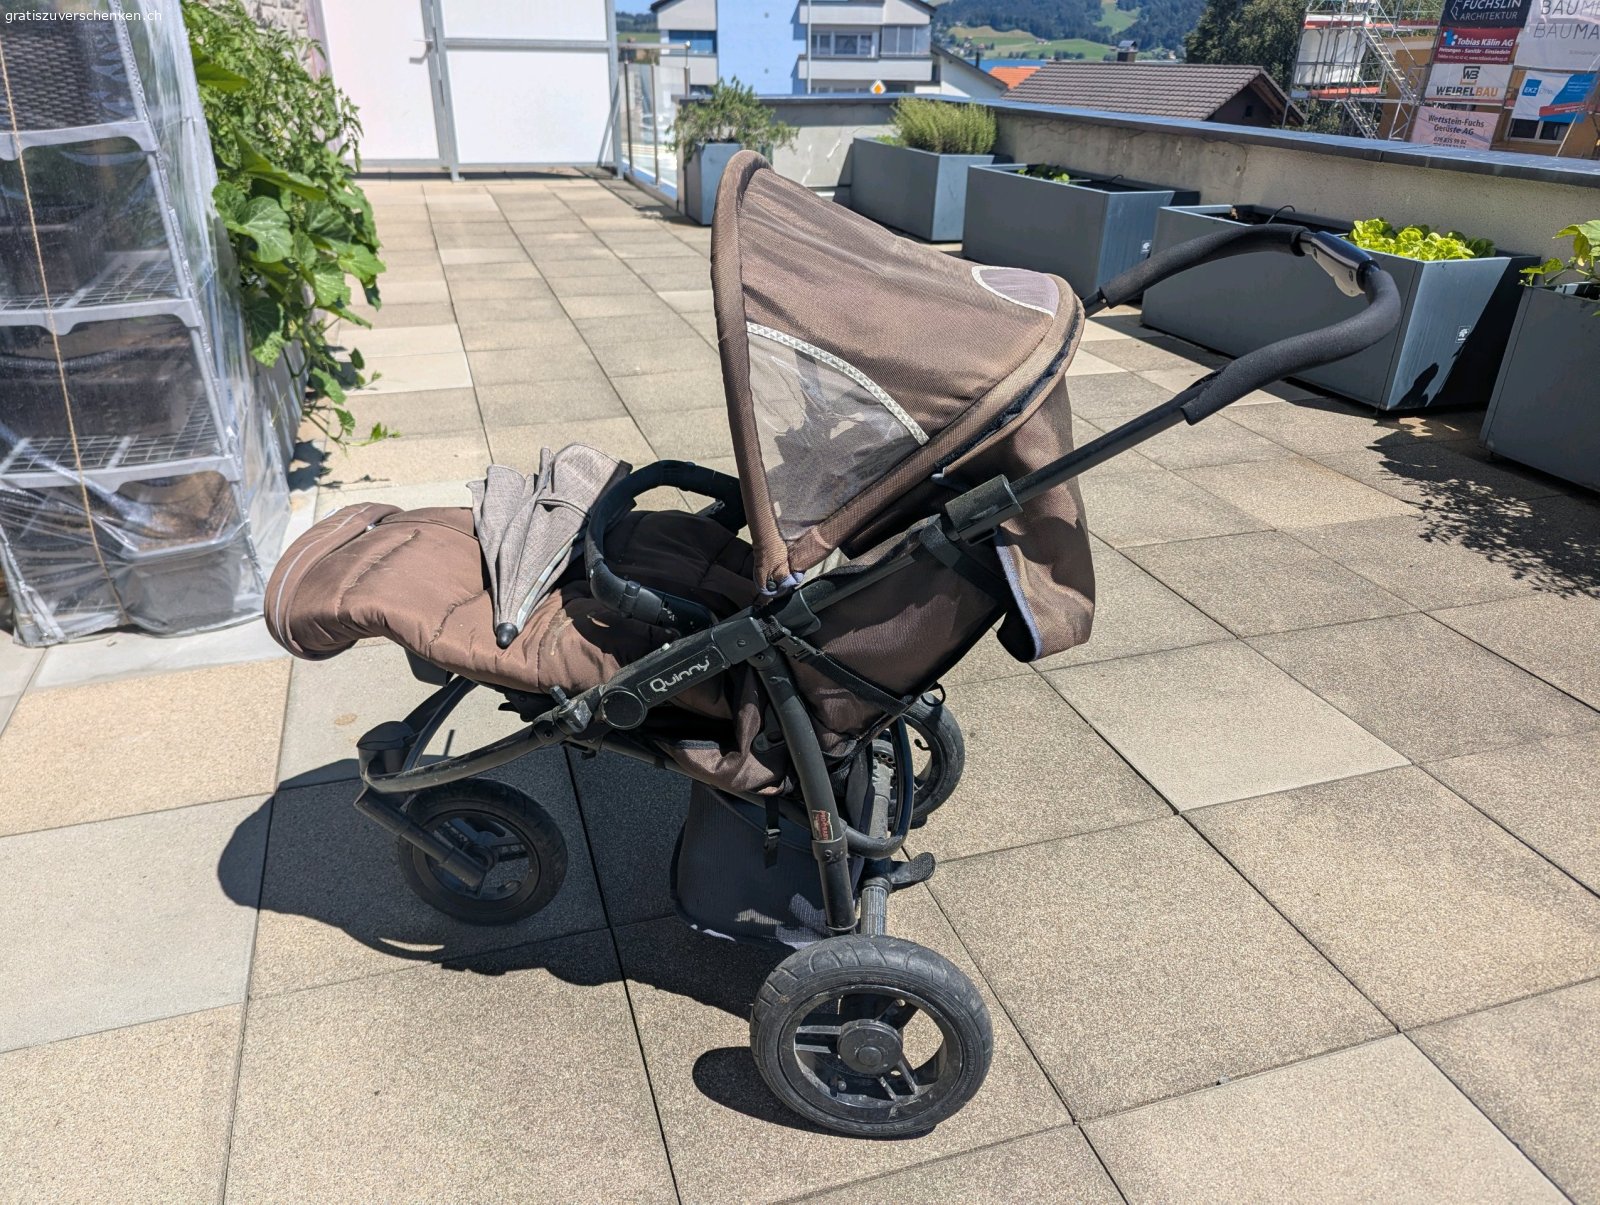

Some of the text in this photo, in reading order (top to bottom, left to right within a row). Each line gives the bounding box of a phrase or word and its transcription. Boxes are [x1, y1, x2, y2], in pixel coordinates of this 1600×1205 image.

[1459, 11, 1518, 21] ARCHITEKTUR
[1457, 37, 1514, 47] Tobias Kälin AG
[1428, 114, 1485, 127] Wettstein-Fuchs
[1434, 124, 1474, 136] Gerüste AG
[649, 655, 710, 693] Quinny
